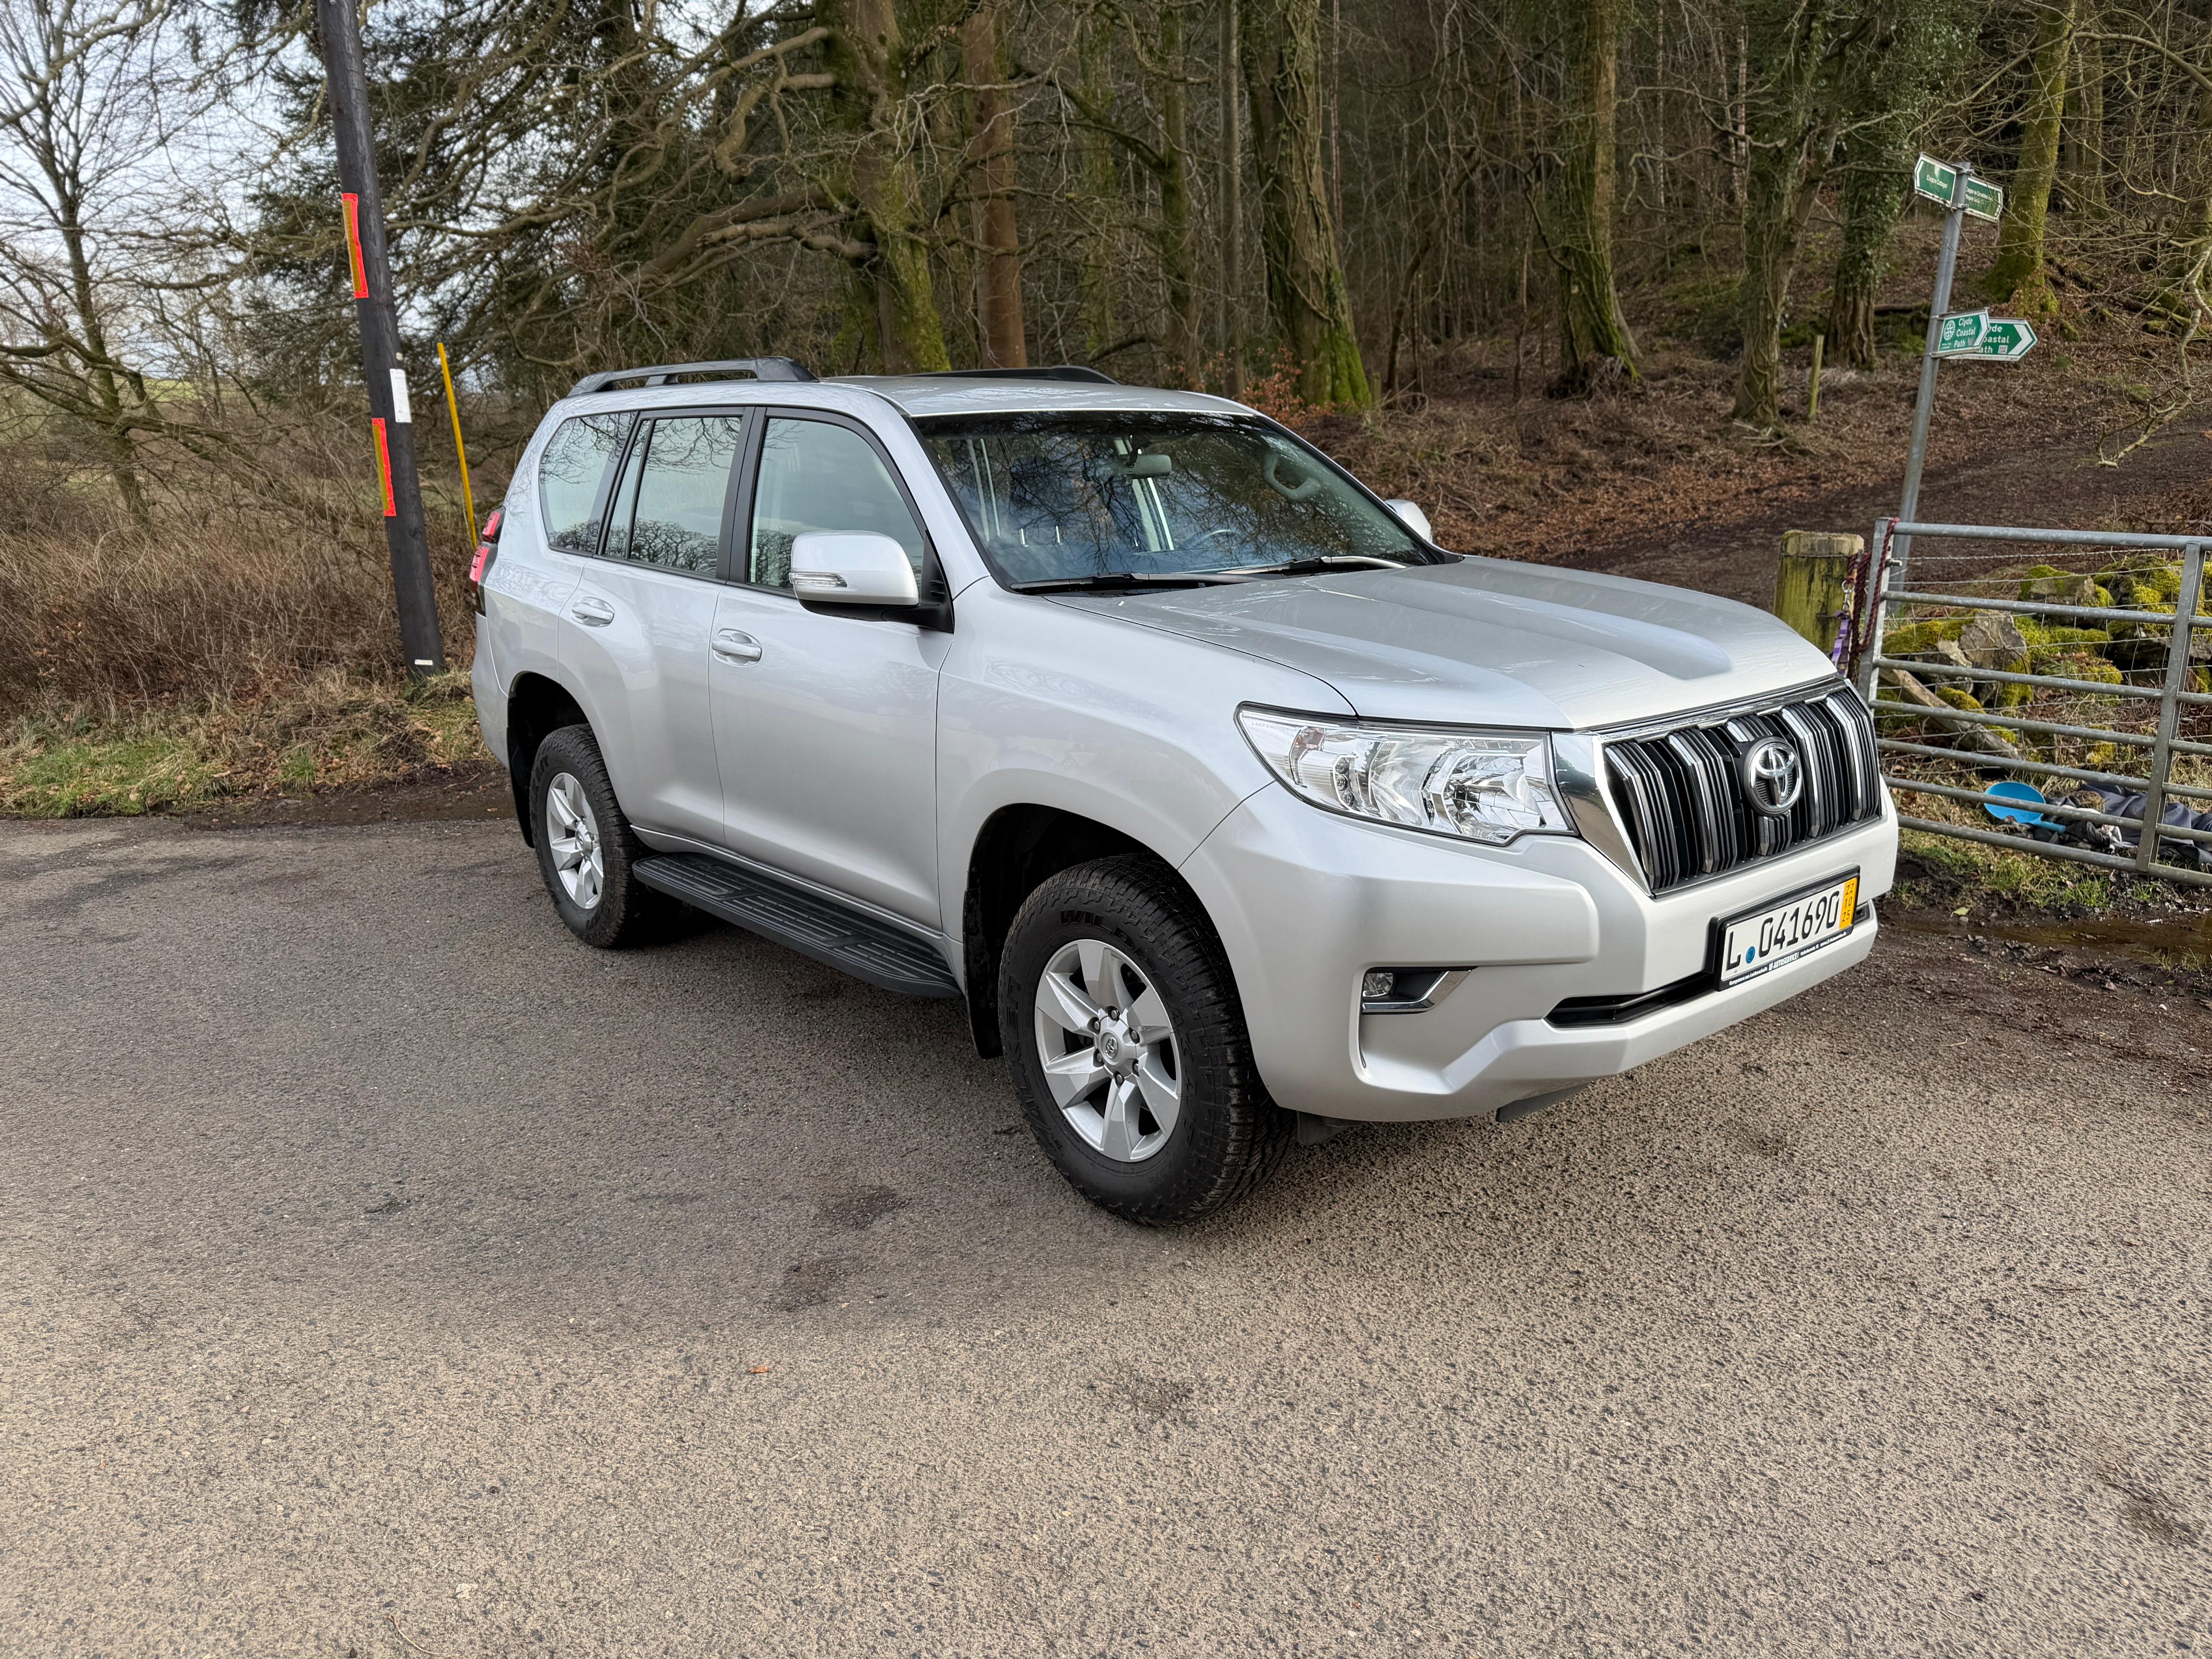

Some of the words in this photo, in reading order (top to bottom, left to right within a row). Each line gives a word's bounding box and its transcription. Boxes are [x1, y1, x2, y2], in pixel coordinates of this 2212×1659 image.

[1958, 317, 1973, 327] Clyde
[1956, 327, 1976, 337] Coastal
[1987, 324, 2002, 333] yde
[1954, 340, 1965, 348] Path
[1845, 882, 1854, 895] 22
[1844, 896, 1853, 909] 10
[1841, 911, 1851, 923] 25
[1726, 931, 1741, 972] L
[1759, 890, 1840, 958] 041690
